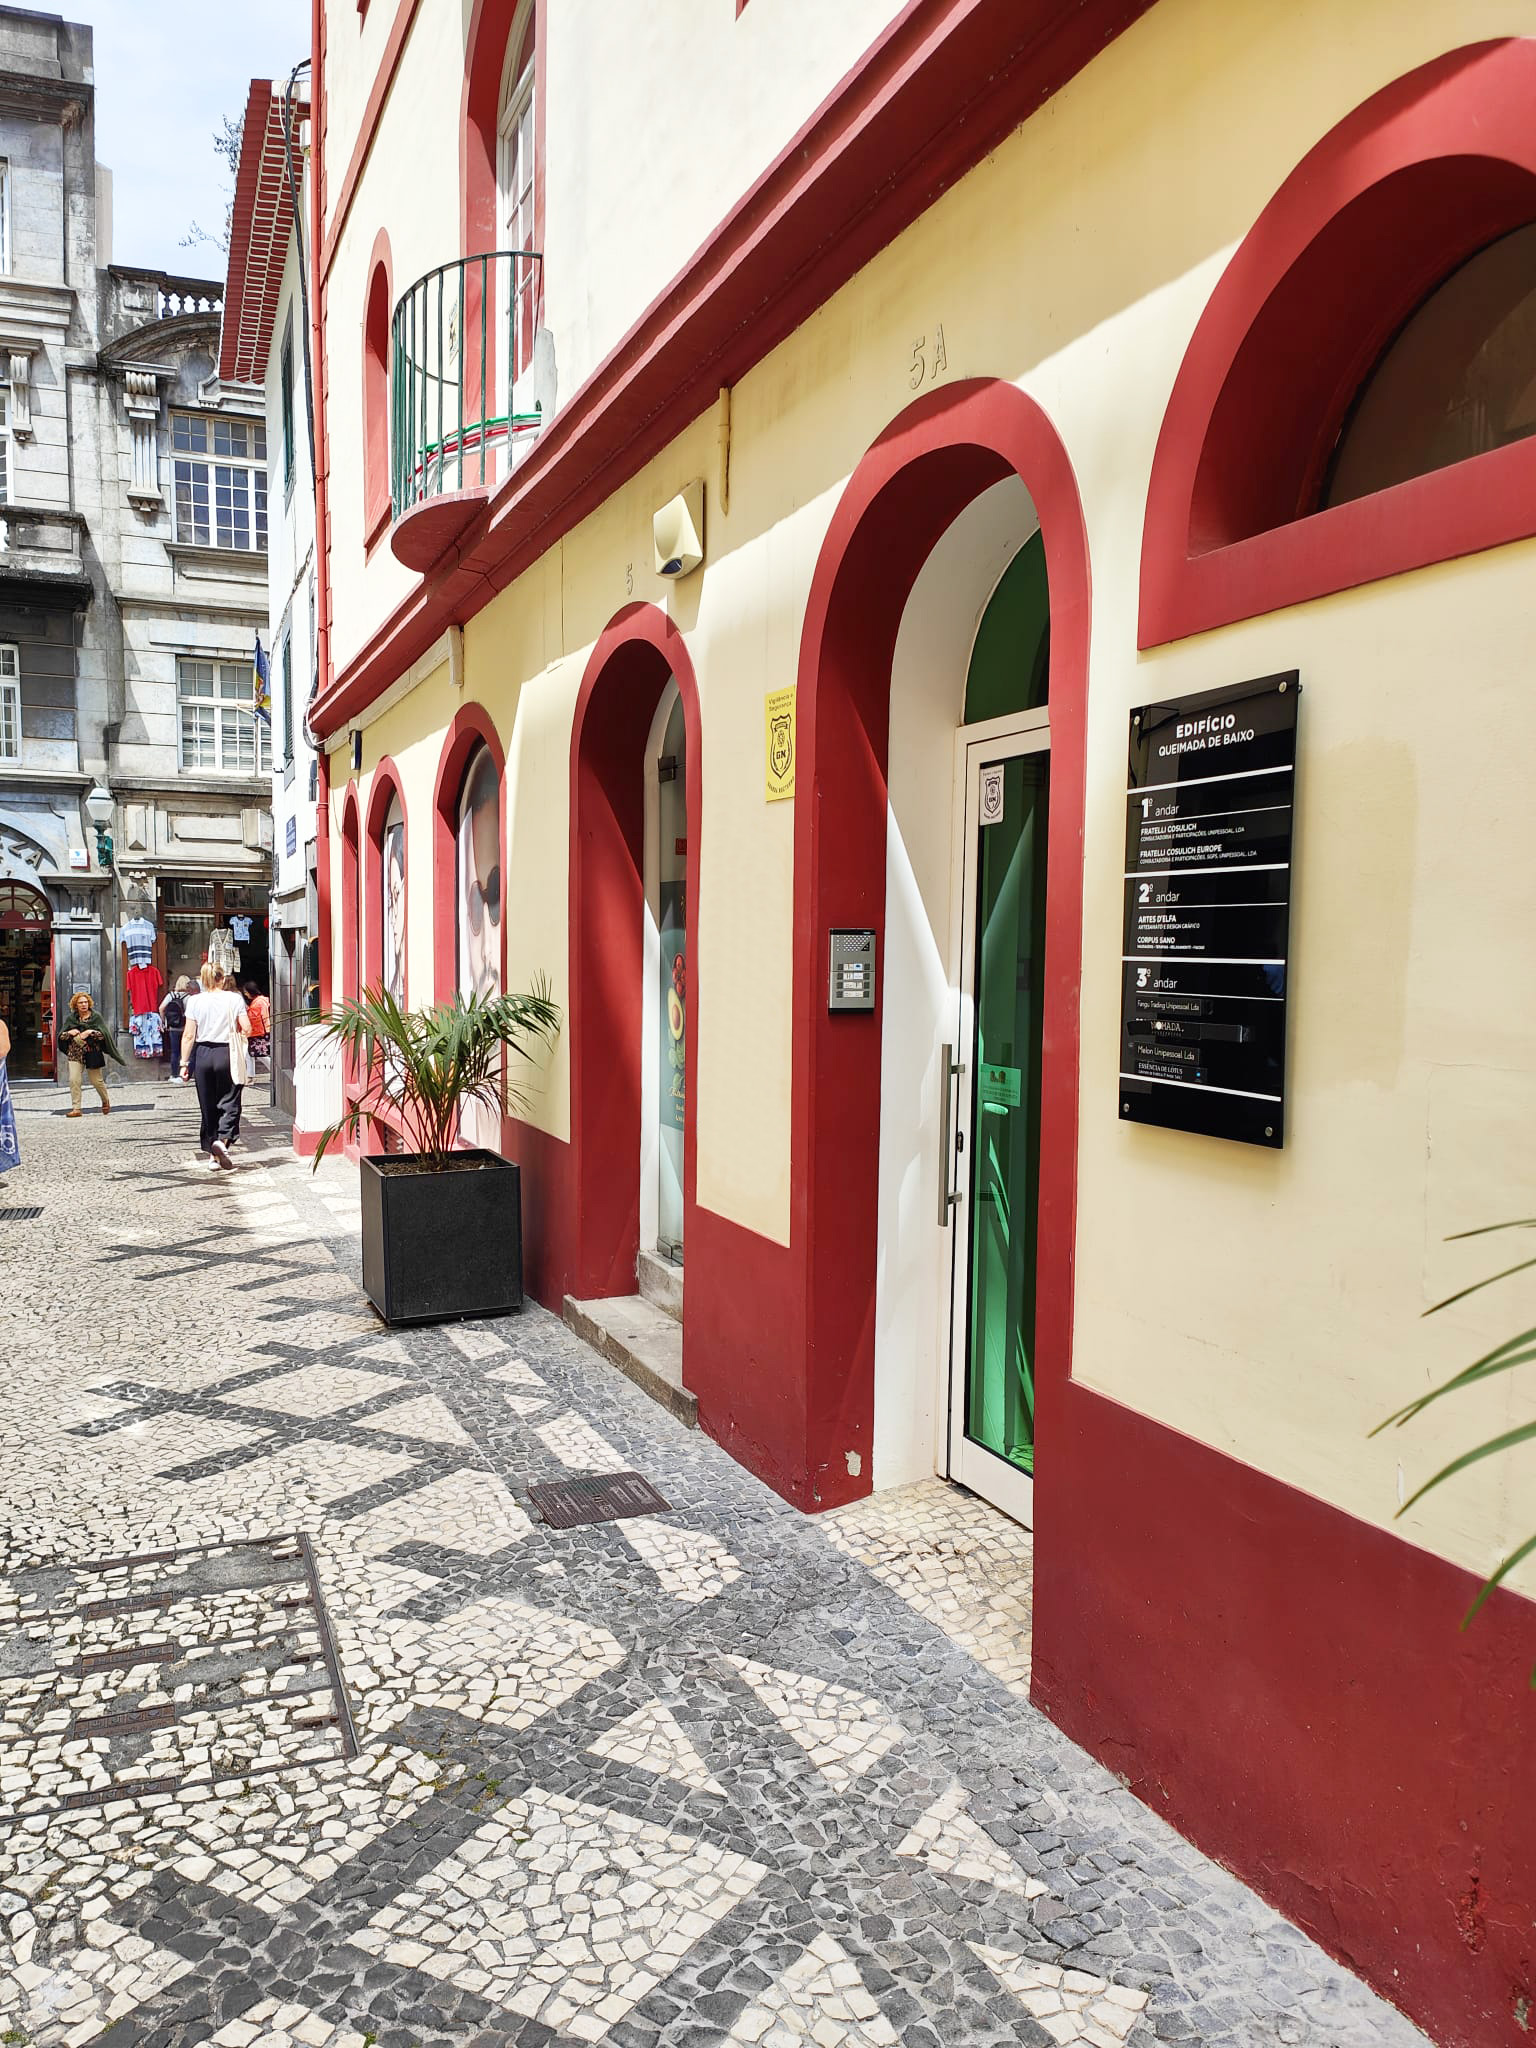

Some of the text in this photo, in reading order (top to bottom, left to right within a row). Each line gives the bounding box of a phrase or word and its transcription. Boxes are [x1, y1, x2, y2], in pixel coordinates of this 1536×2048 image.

[909, 322, 947, 390] 5A
[1176, 713, 1236, 738] EDIFÍCIO
[1158, 729, 1255, 757] QUEIMADA DE BAIXO
[776, 749, 786, 760] GN
[1141, 798, 1180, 818] 1º andar
[1141, 823, 1197, 836] FRATELLI COSULICH
[1140, 844, 1222, 858] FRATELLI COSULICH EUROPE
[1138, 883, 1180, 903] 2º andar
[1136, 968, 1178, 988] 3º andar
[1154, 1048, 1182, 1058] Unipessoal
[1184, 1050, 1194, 1060] Lda
